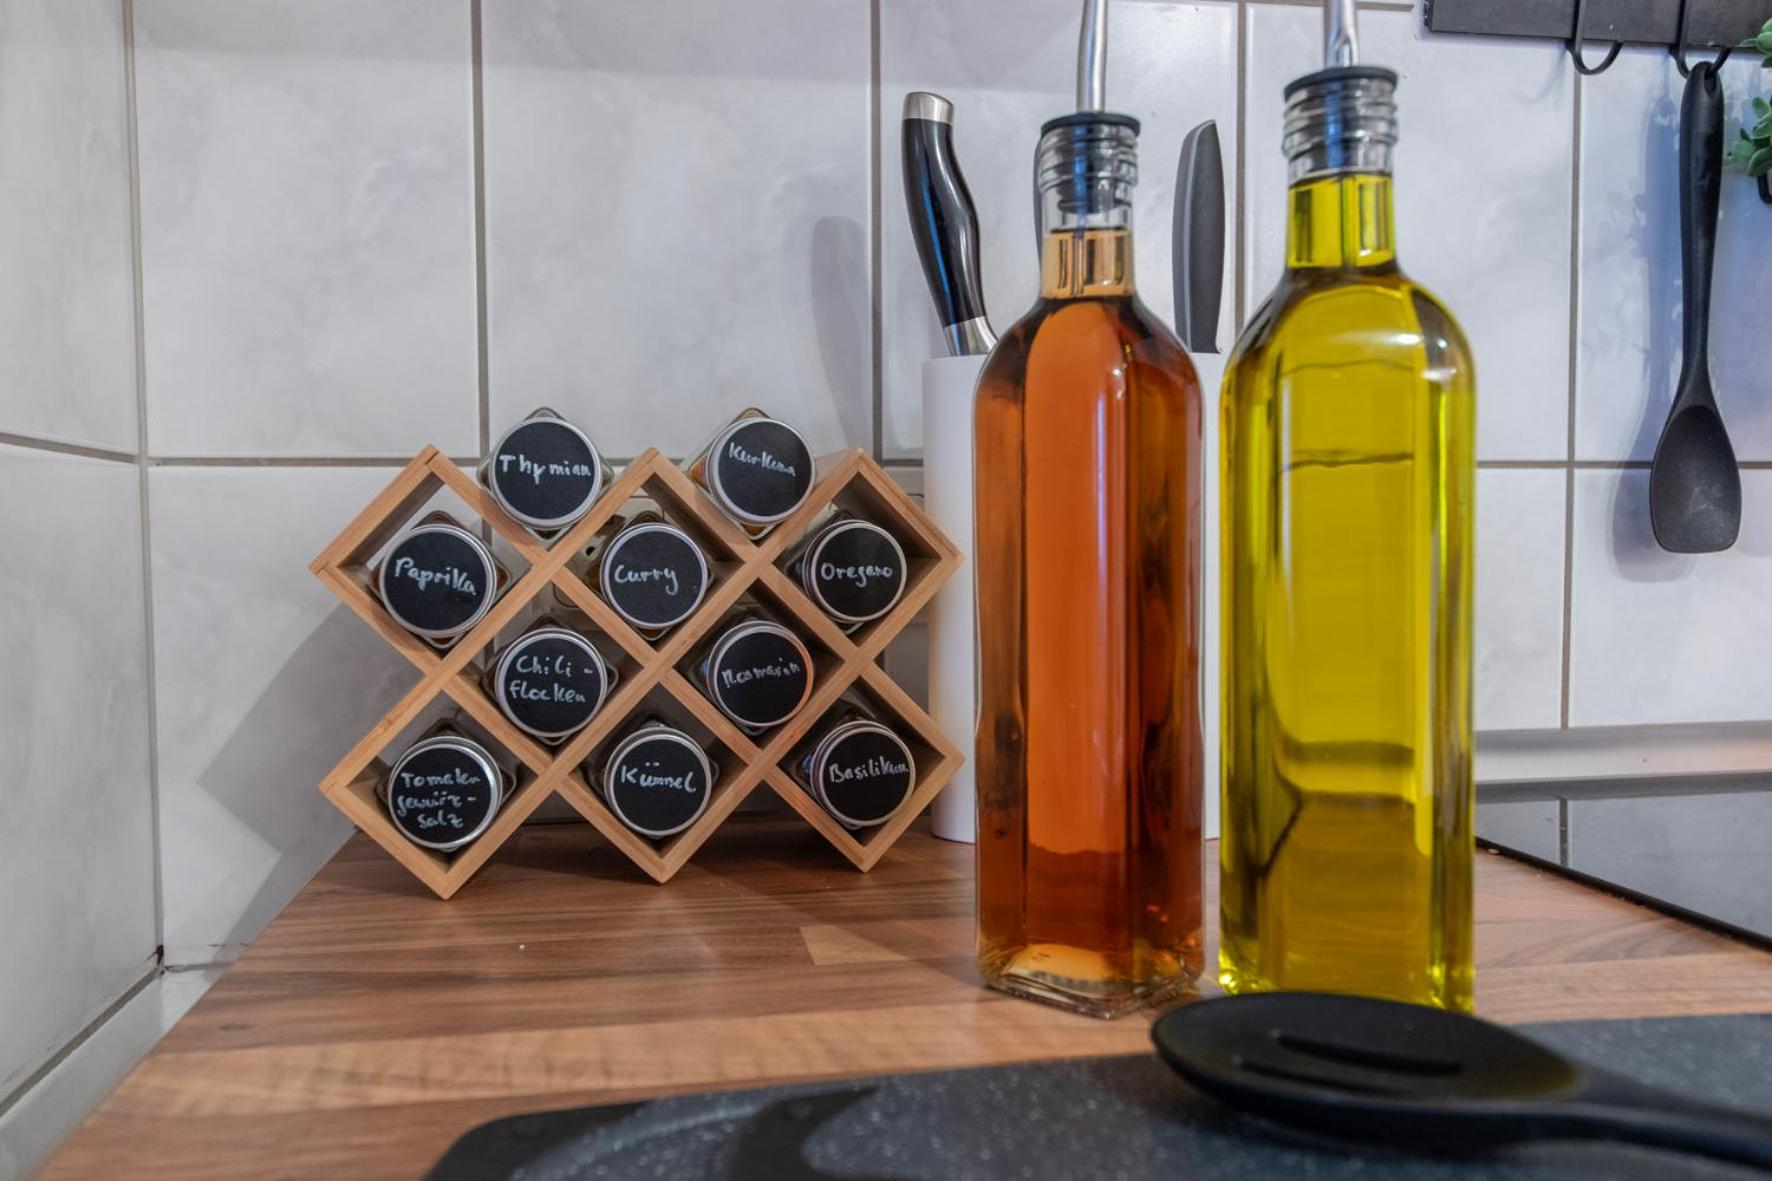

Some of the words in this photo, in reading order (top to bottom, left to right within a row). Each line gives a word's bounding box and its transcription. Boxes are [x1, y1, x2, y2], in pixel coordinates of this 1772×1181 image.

[499, 454, 591, 484] Thymian
[394, 557, 477, 596] Paprika
[614, 565, 678, 595] Curry
[820, 562, 893, 588] Oregano
